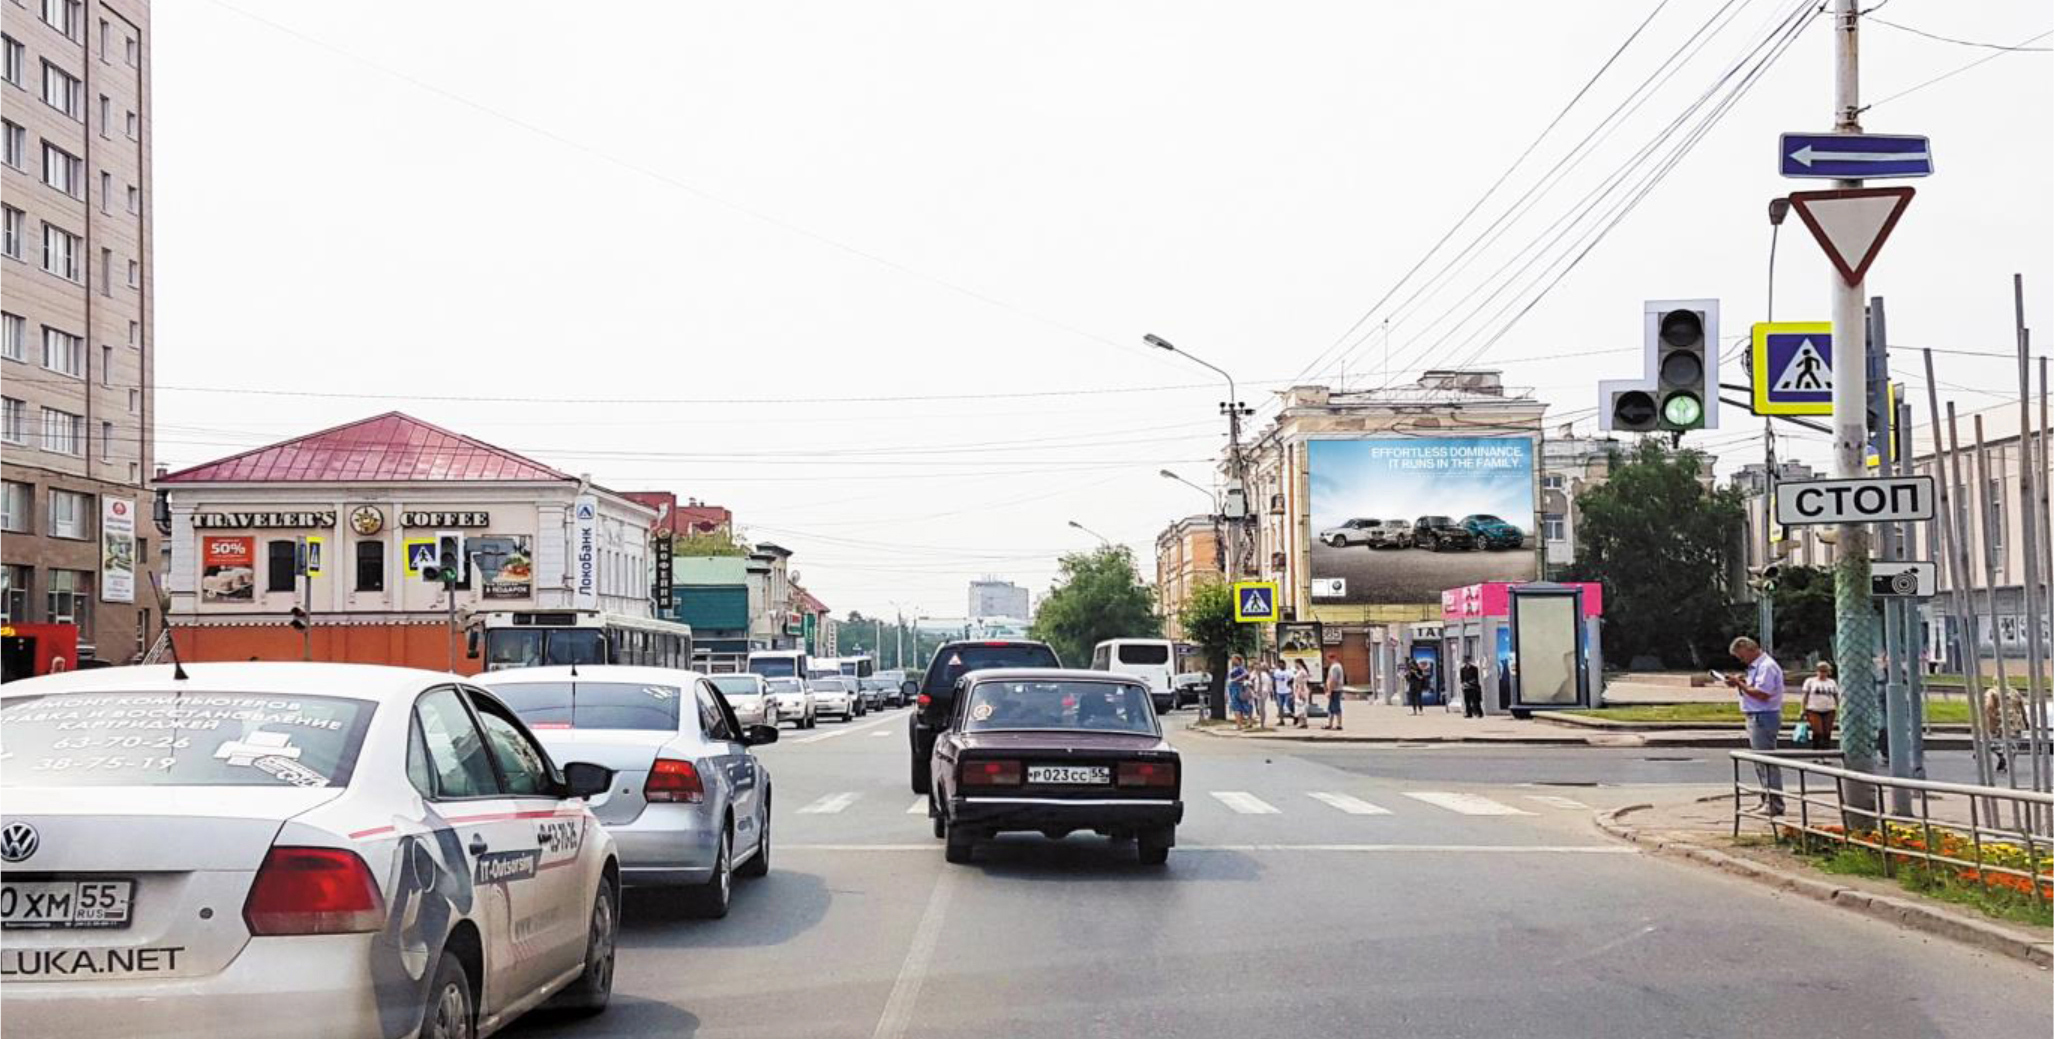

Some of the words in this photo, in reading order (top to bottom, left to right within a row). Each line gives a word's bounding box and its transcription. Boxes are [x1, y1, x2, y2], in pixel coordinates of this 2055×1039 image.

[1371, 446, 1447, 458] EFFORTLESS
[1450, 446, 1523, 457] DOMINANCE.
[1388, 458, 1400, 469] IT
[1402, 458, 1435, 469] RUNS
[1437, 458, 1448, 469] IN
[1451, 458, 1474, 469] THE
[1476, 457, 1523, 468] FAMILY.
[1796, 484, 1919, 516] СТОП
[192, 511, 336, 528] TRAVELER'S
[400, 512, 489, 528] COFFEE
[210, 542, 247, 555] 50%
[115, 709, 343, 730] ВОССТАНОВЛЕНИЕ
[53, 736, 191, 749] 63-70-26
[31, 755, 177, 772] 38-75-19
[81, 884, 117, 909] 55
[76, 909, 105, 919] RUS
